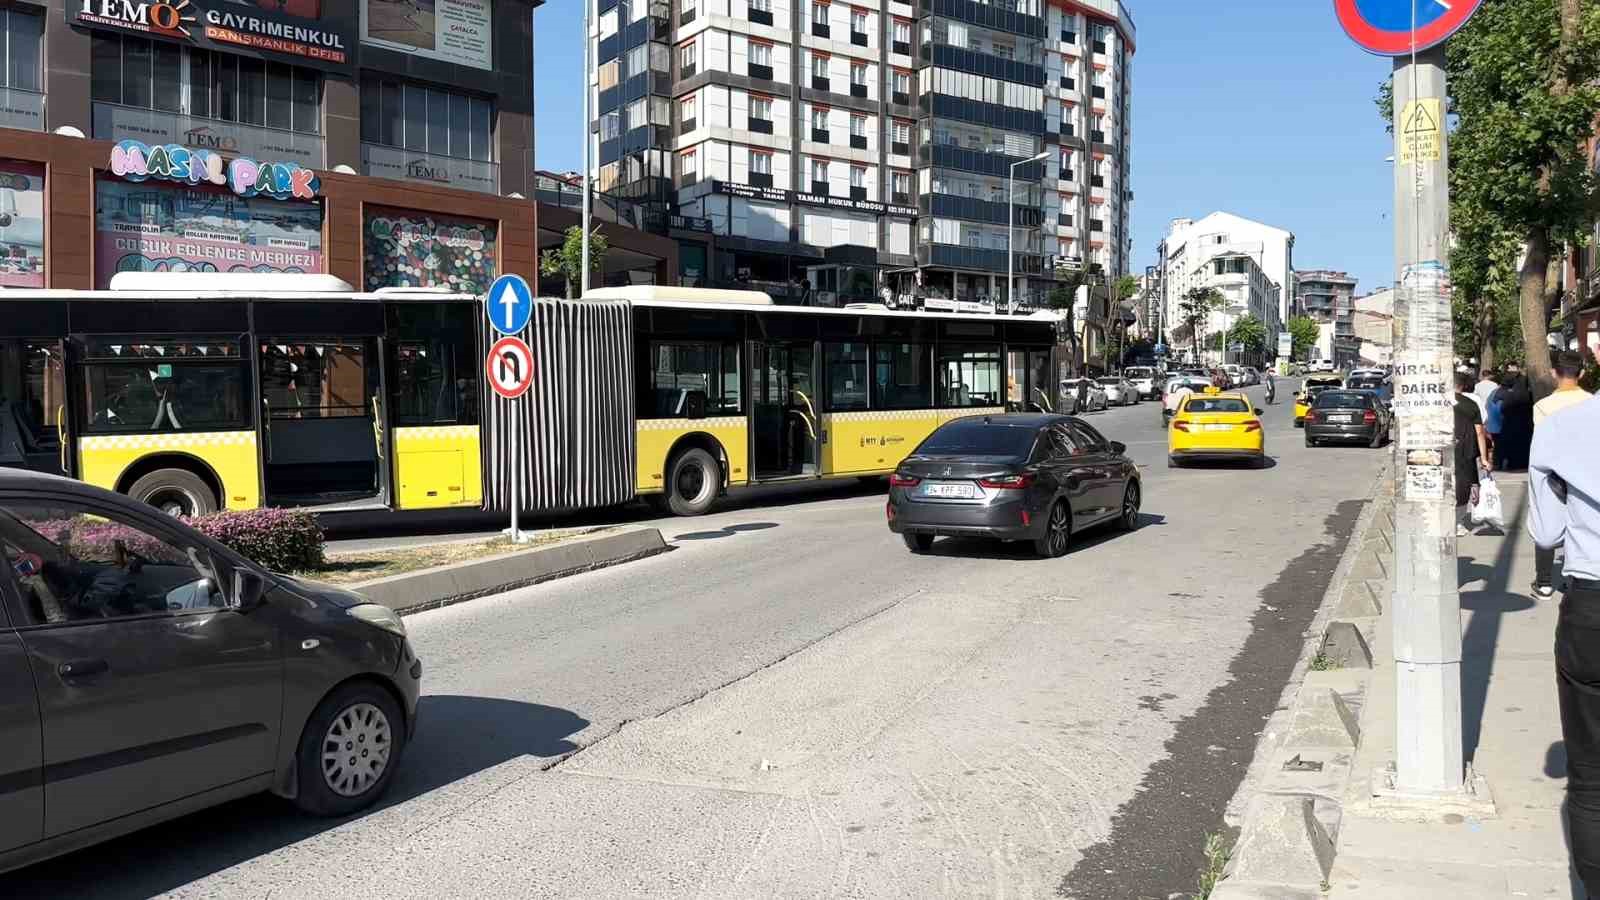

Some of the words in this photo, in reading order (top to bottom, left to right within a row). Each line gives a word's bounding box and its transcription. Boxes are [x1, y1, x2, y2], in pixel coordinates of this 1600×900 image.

[111, 145, 226, 185] MASAL
[233, 158, 315, 198] PARK
[797, 193, 825, 204] TAMAN
[828, 198, 854, 208] HUKUK
[1401, 381, 1447, 395] DAİRE
